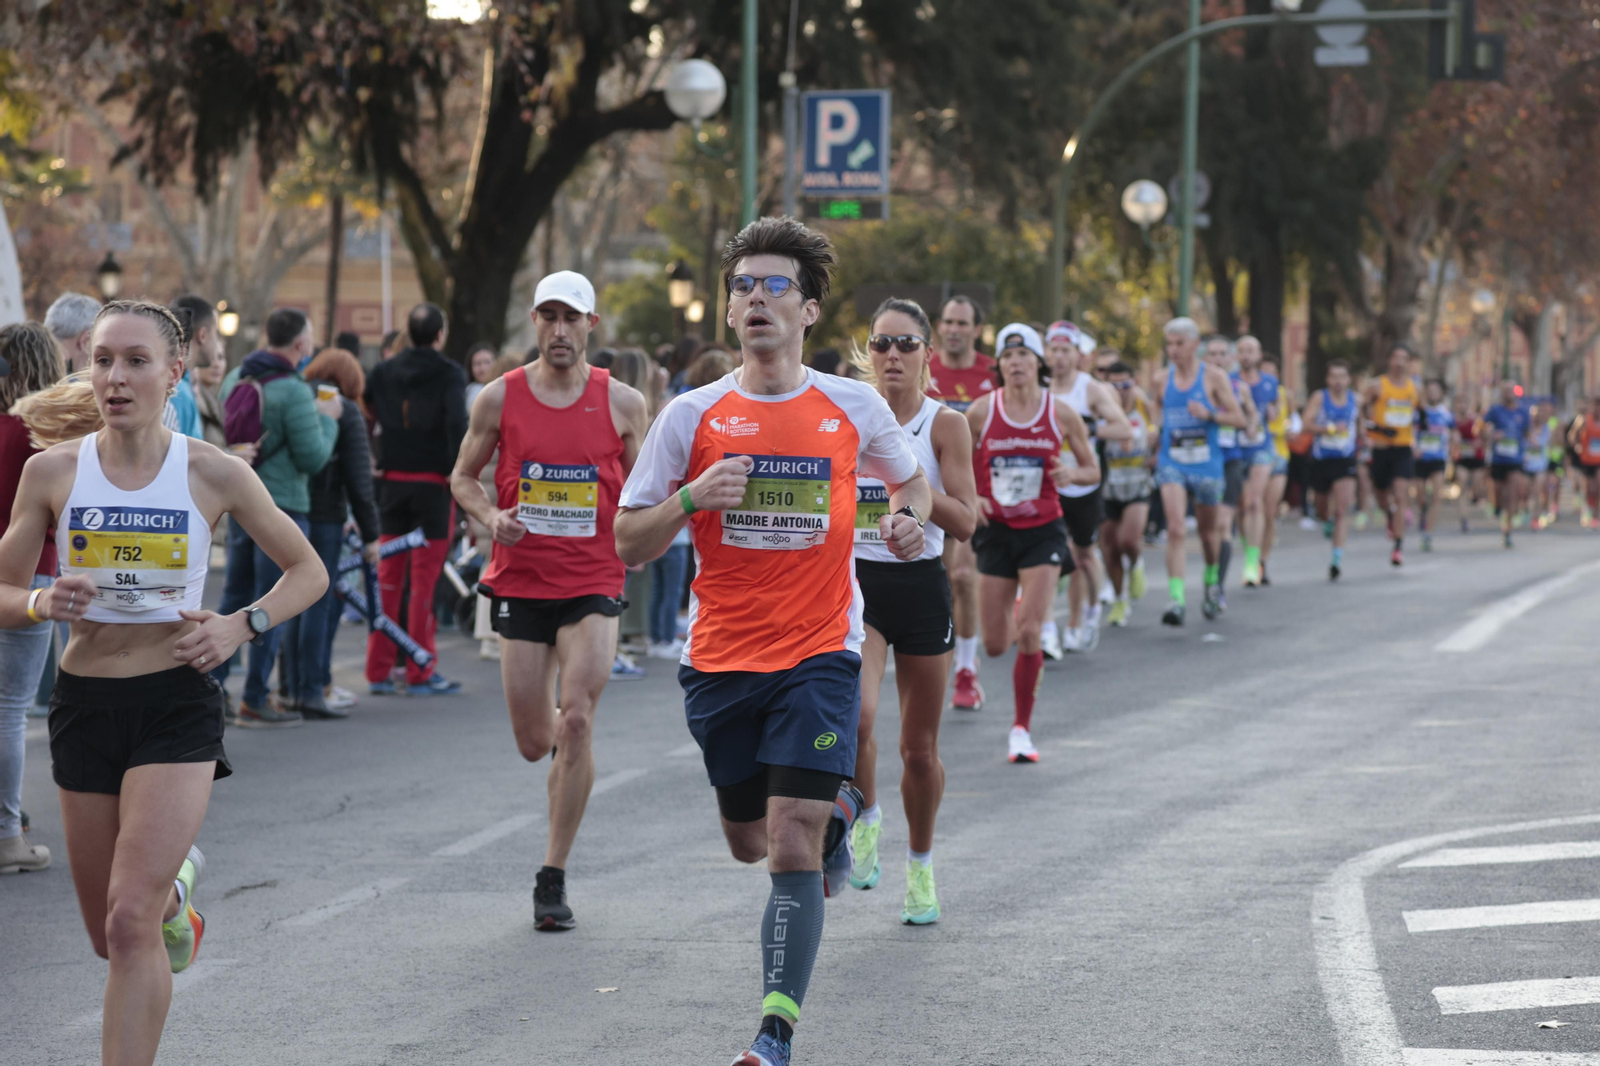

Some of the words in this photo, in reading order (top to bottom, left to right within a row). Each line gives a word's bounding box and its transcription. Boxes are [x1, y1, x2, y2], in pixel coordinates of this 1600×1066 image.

[815, 98, 860, 168] P
[545, 468, 589, 480] ZURICH
[758, 460, 818, 475] ZURICH
[548, 491, 568, 502] 594
[758, 490, 794, 506] 1510
[520, 505, 548, 517] PEDRO
[550, 509, 594, 519] MACHADO
[107, 513, 174, 528] ZURICH
[726, 513, 768, 527] MADRE
[772, 516, 823, 529] ANTONIA
[112, 546, 142, 562] 752
[115, 572, 139, 585] SAL
